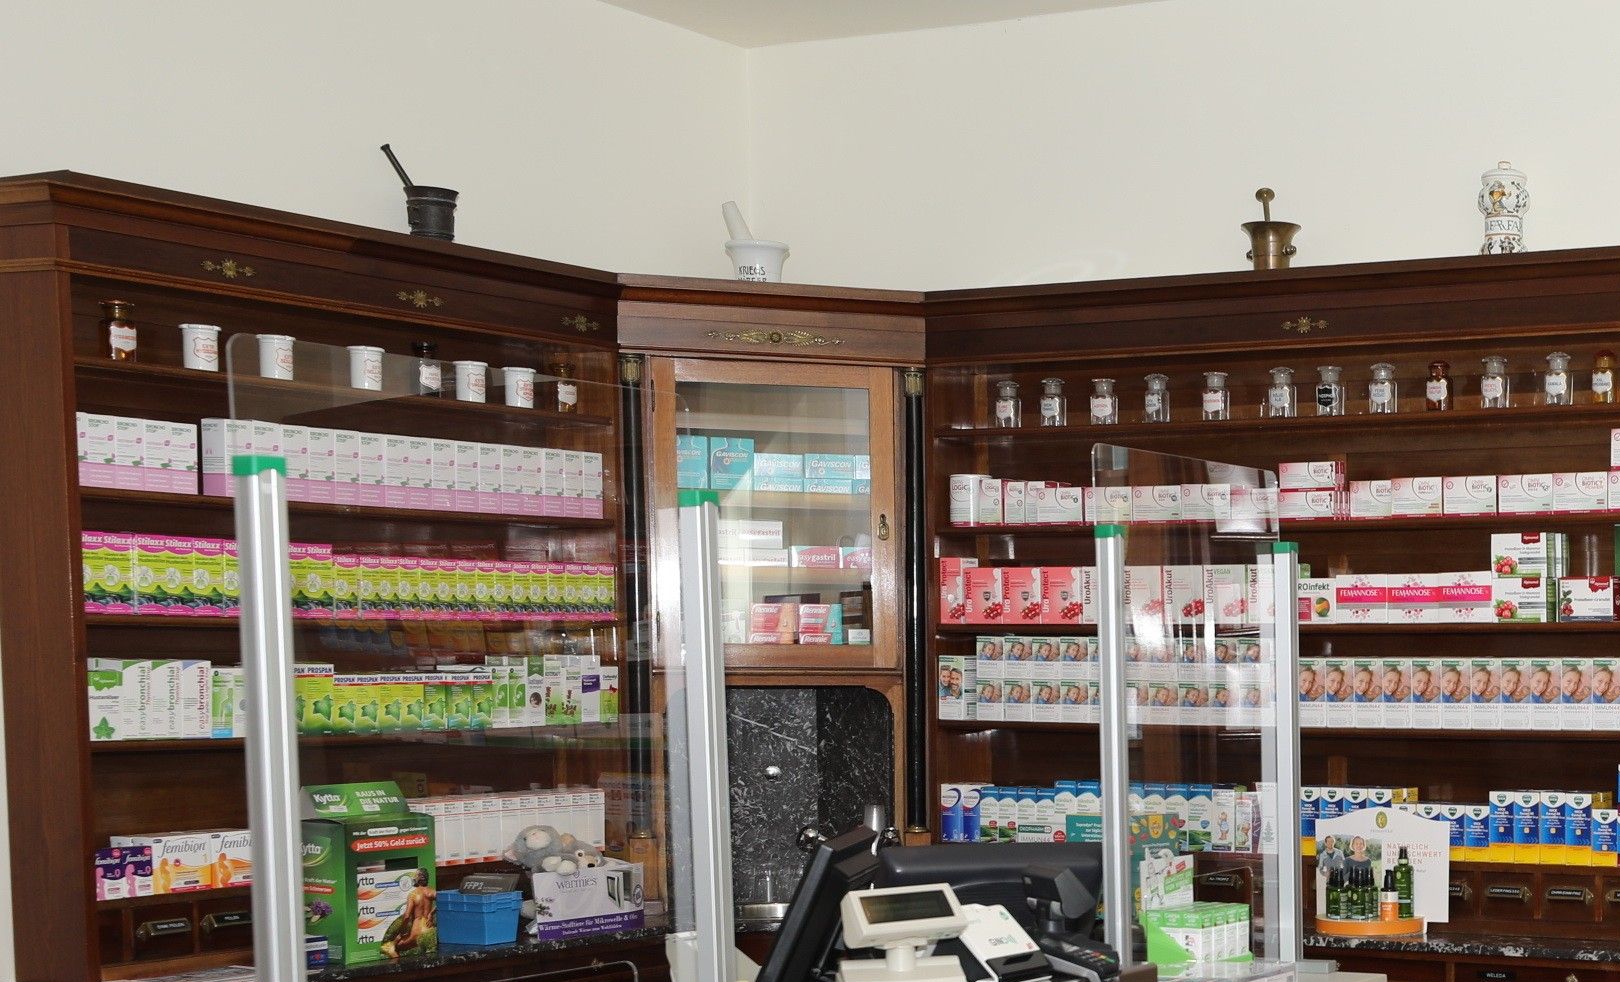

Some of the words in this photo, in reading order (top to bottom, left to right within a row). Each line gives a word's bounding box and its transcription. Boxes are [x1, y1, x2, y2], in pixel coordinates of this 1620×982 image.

[811, 459, 850, 469] GAVISCON
[760, 483, 801, 492] GAVISCON
[810, 484, 850, 493] GAVISCON
[104, 535, 131, 546] Stilaxx
[137, 536, 164, 547] Stilaxx
[165, 539, 192, 549] Stilaxx
[194, 540, 221, 550] Stilaxx
[307, 545, 332, 554] Stilaxx
[1083, 570, 1091, 605] UroAkut
[1165, 569, 1173, 605] UroAkut
[1442, 587, 1483, 596] FEMANNOSE
[1340, 589, 1379, 597] FEMANNOSE
[1391, 588, 1431, 597] FEMANNOSE
[754, 606, 779, 614] Rennie
[803, 606, 827, 614] Rennie
[752, 634, 777, 643] Rennie
[803, 635, 827, 643] Rennie
[307, 666, 333, 674] PROSPAN
[138, 666, 146, 730] easybronchial
[167, 666, 175, 730] easybronchial
[197, 666, 205, 730] easybronchial
[355, 790, 376, 798] RAUS
[313, 794, 340, 805] Kytta
[373, 796, 400, 805] NATUR
[158, 839, 206, 857] femibion
[356, 842, 373, 851] Jetzt
[373, 840, 390, 849] 50%
[390, 838, 401, 847] Geld
[401, 837, 427, 846] zurück
